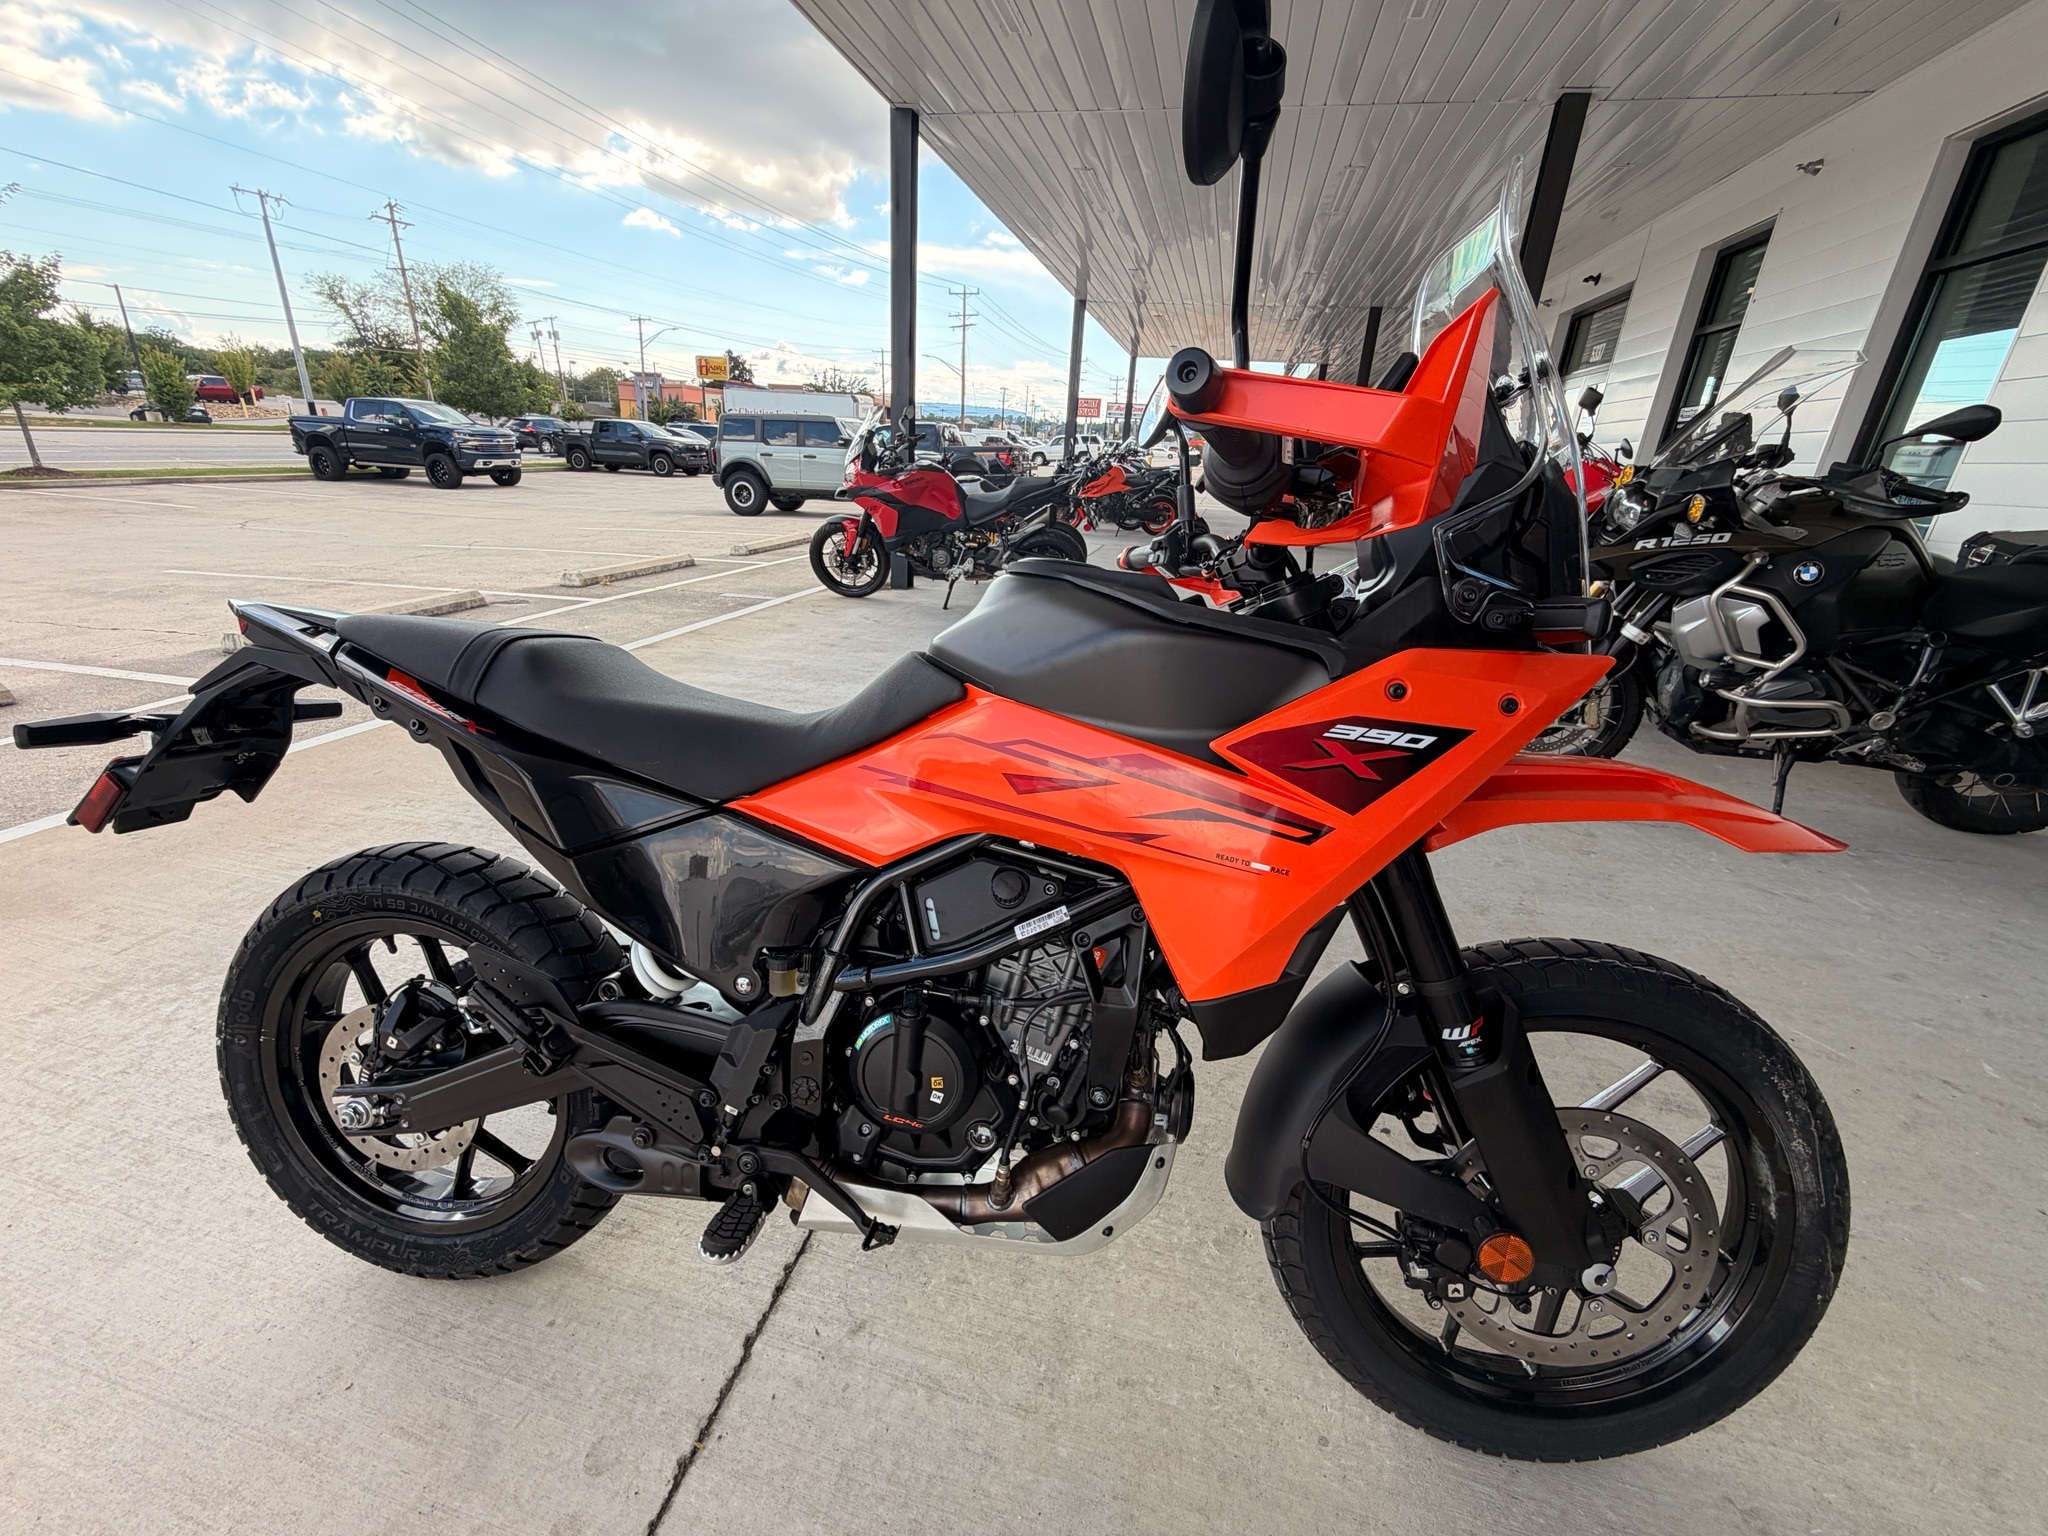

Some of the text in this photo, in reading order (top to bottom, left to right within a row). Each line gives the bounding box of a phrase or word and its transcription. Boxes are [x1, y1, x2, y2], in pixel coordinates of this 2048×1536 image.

[1078, 399, 1098, 408] AMILY
[1323, 724, 1439, 749] 390
[1280, 738, 1414, 781] X
[1215, 853, 1291, 877] READY TO RACE
[442, 913, 455, 923] 17
[457, 921, 468, 931] R
[860, 1015, 890, 1041] MOTOREX
[1457, 1036, 1482, 1048] APEX
[932, 1079, 943, 1088] OK
[932, 1092, 942, 1102] OK
